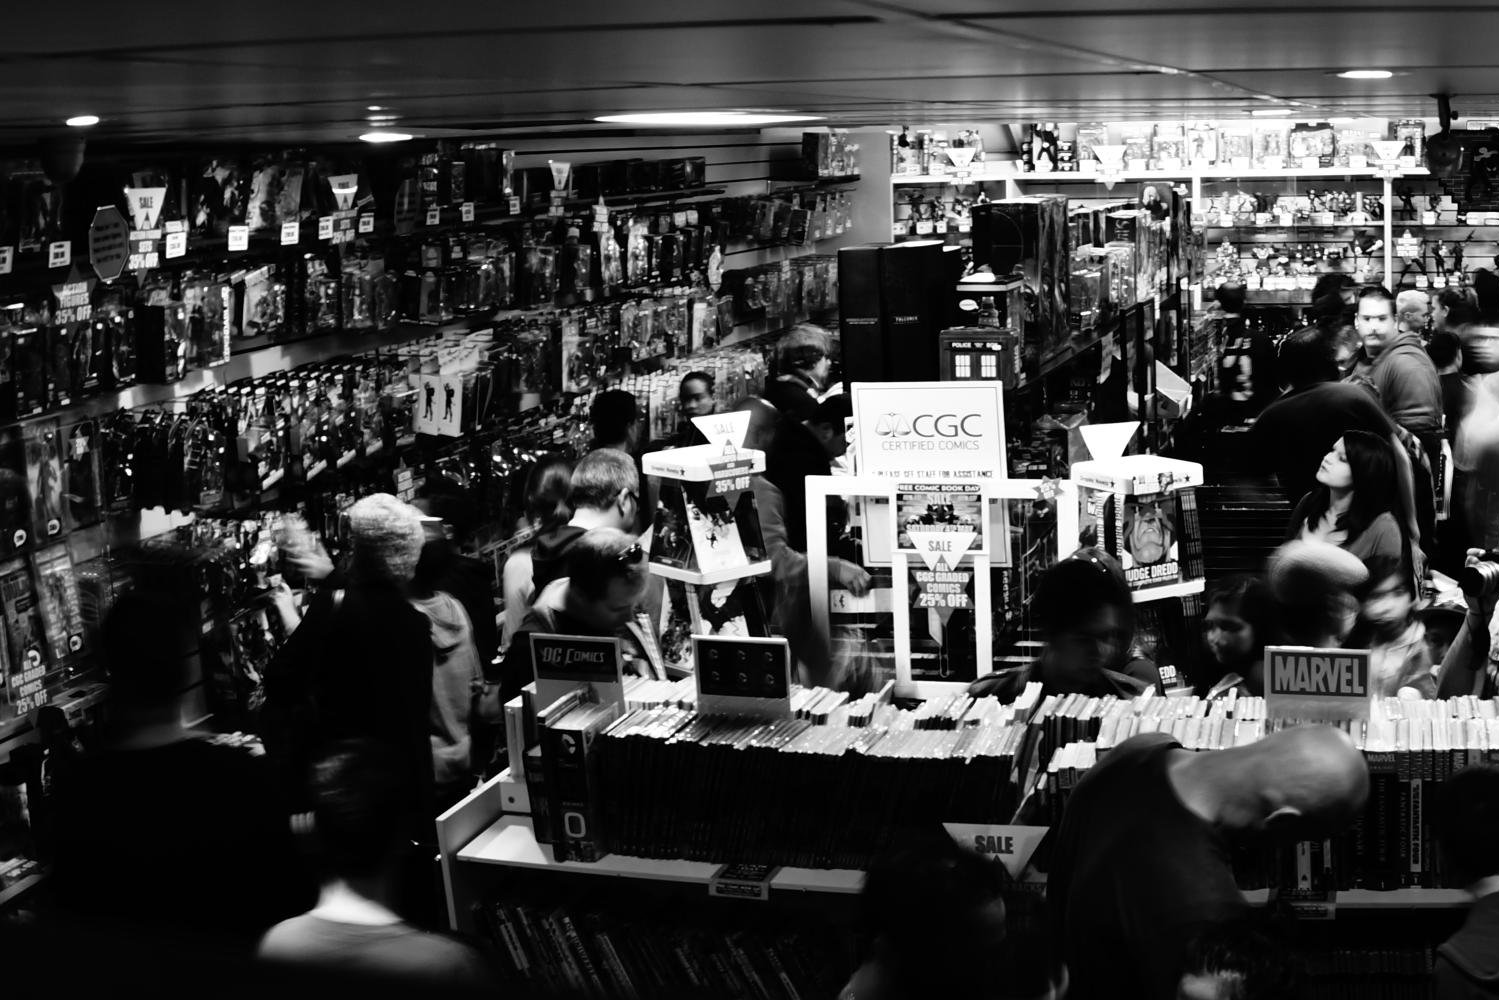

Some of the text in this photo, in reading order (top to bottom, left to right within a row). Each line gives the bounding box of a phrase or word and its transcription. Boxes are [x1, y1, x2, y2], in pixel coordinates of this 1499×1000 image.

[55, 305, 92, 325] 35% OFF
[912, 413, 983, 437] CGC
[881, 440, 980, 451] CERTIFIED COMICS
[914, 484, 940, 492] COMIC
[941, 484, 963, 492] BOOK
[964, 484, 981, 492] DAY
[928, 540, 952, 552] SALE
[1151, 561, 1179, 578] DREDD
[926, 582, 960, 594] COMICS
[919, 593, 969, 607] 25% OFF
[1273, 655, 1366, 694] MARVEL
[1367, 752, 1396, 763] MARVEL
[1412, 800, 1420, 842] FANTASTIC
[974, 835, 1014, 854] SALE
[1412, 842, 1420, 865] FOUR
